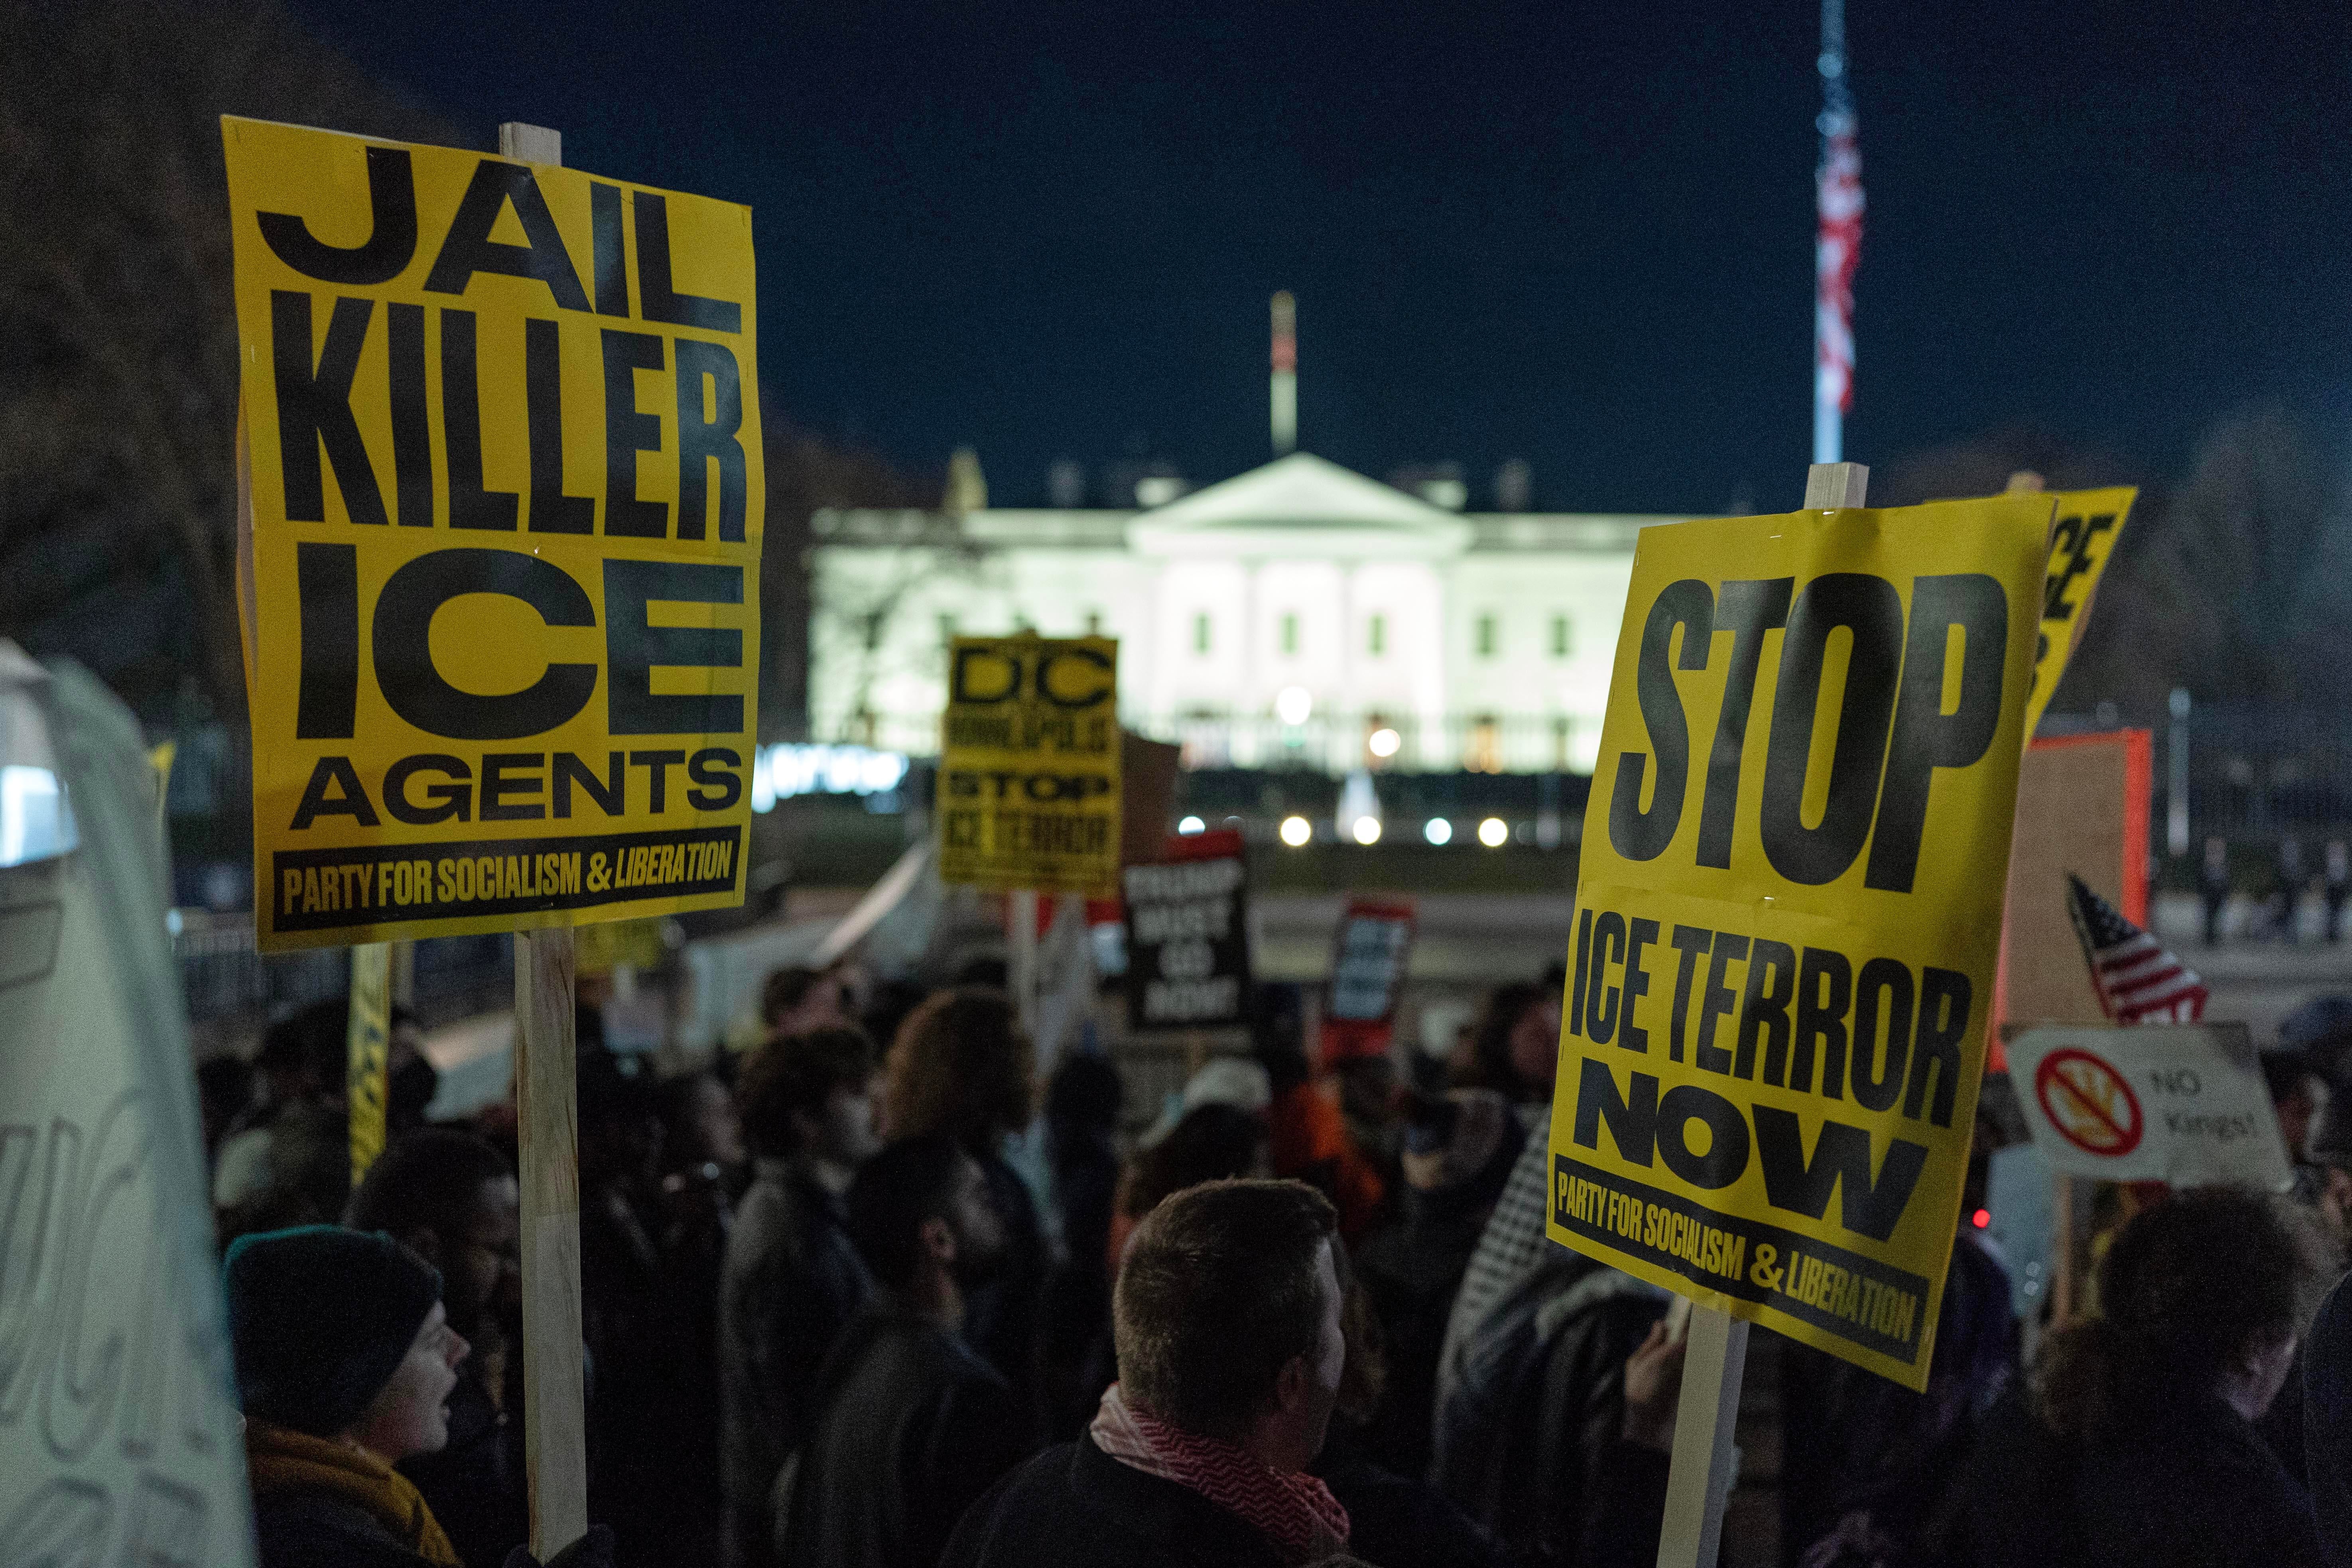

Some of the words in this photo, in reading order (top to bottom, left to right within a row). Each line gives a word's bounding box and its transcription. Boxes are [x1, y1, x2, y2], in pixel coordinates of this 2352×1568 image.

[256, 146, 742, 334] JAIL
[271, 290, 747, 542] KILLER
[296, 542, 745, 740] ICE
[954, 646, 1111, 707] DC
[289, 747, 742, 830] AGENTS
[949, 770, 1110, 799] STOP
[1609, 573, 2008, 893] STOP
[283, 863, 375, 914] PARTY
[376, 859, 433, 907] FOR
[437, 852, 581, 902] SOCIALISM
[586, 852, 613, 892] &
[614, 840, 733, 886] LIBERATION
[1570, 908, 1661, 1053] ICE
[1669, 924, 1972, 1128] TERROR
[2150, 1068, 2202, 1096] NO
[1573, 1056, 1928, 1241] NOW
[1558, 1171, 1608, 1227] PARTY
[1607, 1191, 1643, 1242] FOR
[1644, 1203, 1746, 1280] SOCIALISM
[1750, 1243, 1784, 1292] &
[1786, 1251, 1917, 1342] LIBERATION
